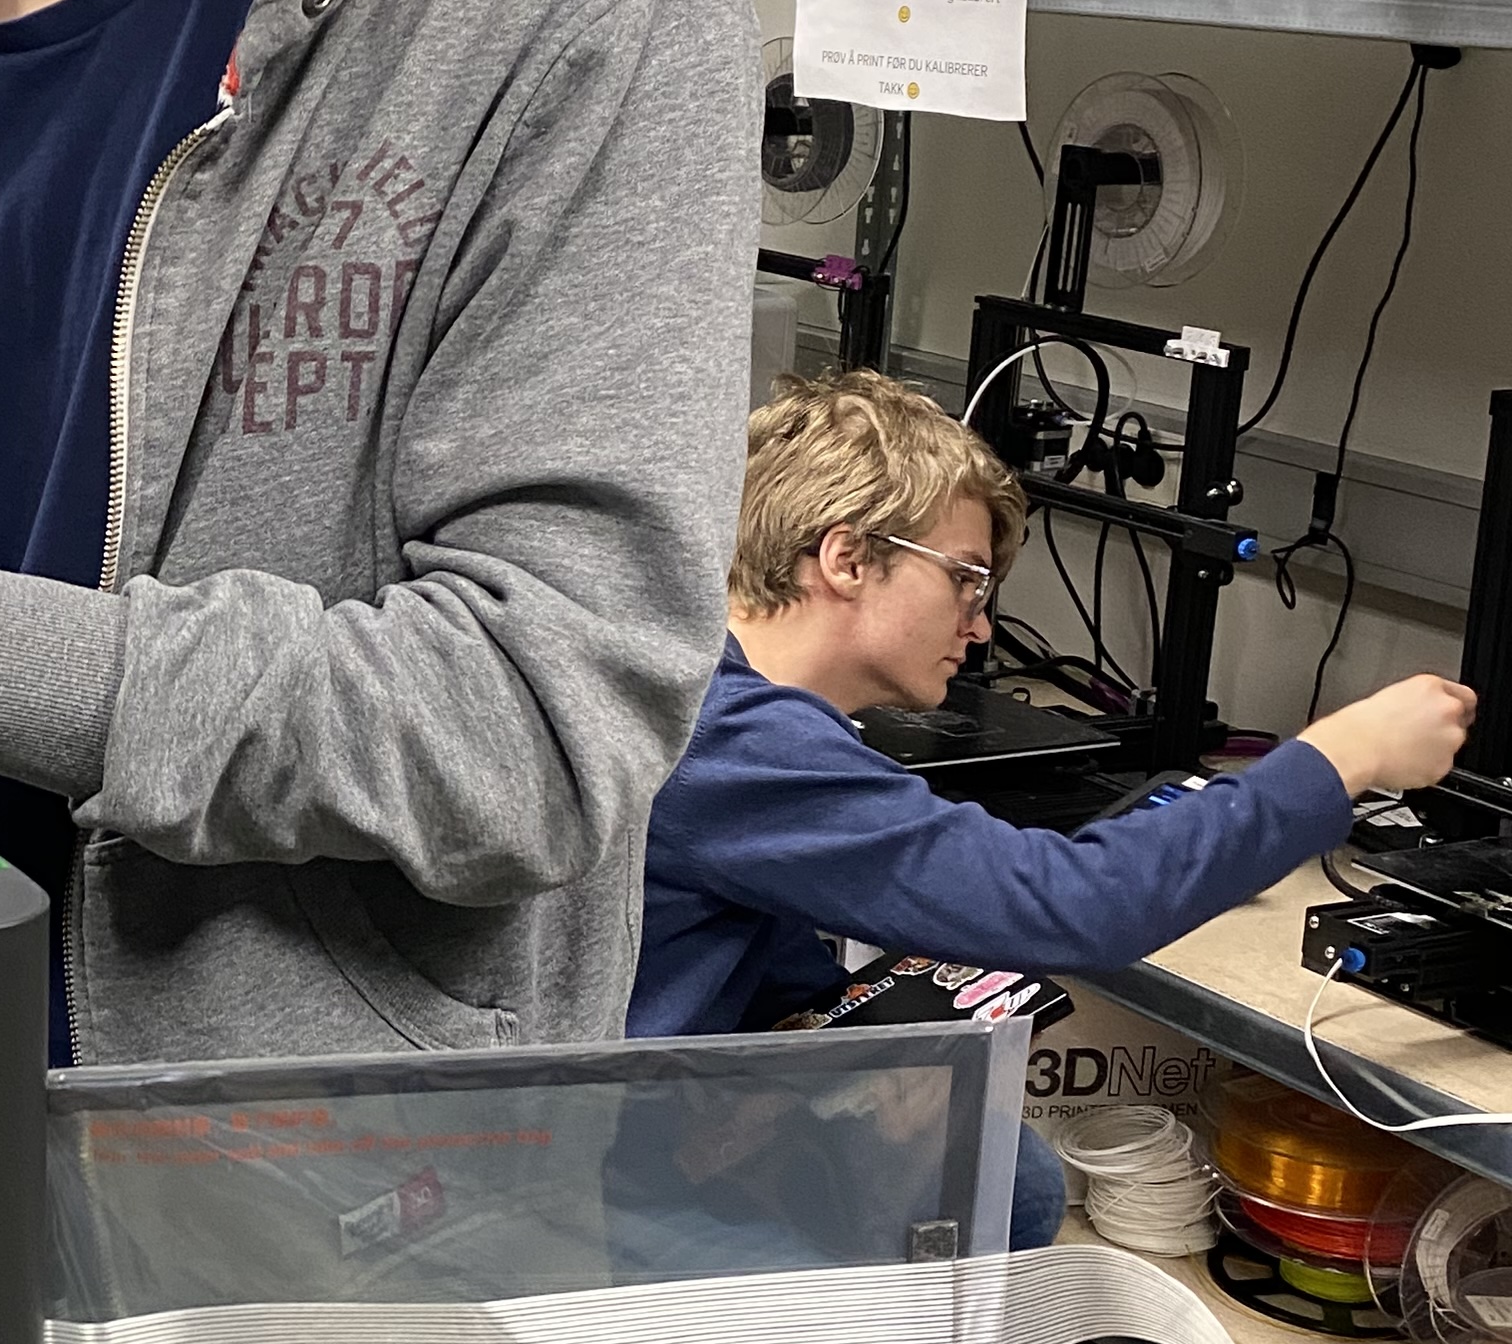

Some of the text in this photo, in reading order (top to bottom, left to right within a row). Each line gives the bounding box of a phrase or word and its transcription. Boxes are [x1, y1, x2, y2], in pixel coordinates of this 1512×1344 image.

[822, 48, 988, 77] PRØV Å PRINT FØR DU KALIBRERER
[879, 81, 905, 95] TAKK
[331, 199, 364, 250] 7
[243, 350, 376, 436] EPT
[1024, 1045, 1216, 1098] 3DNet
[1022, 1106, 1043, 1120] 3D
